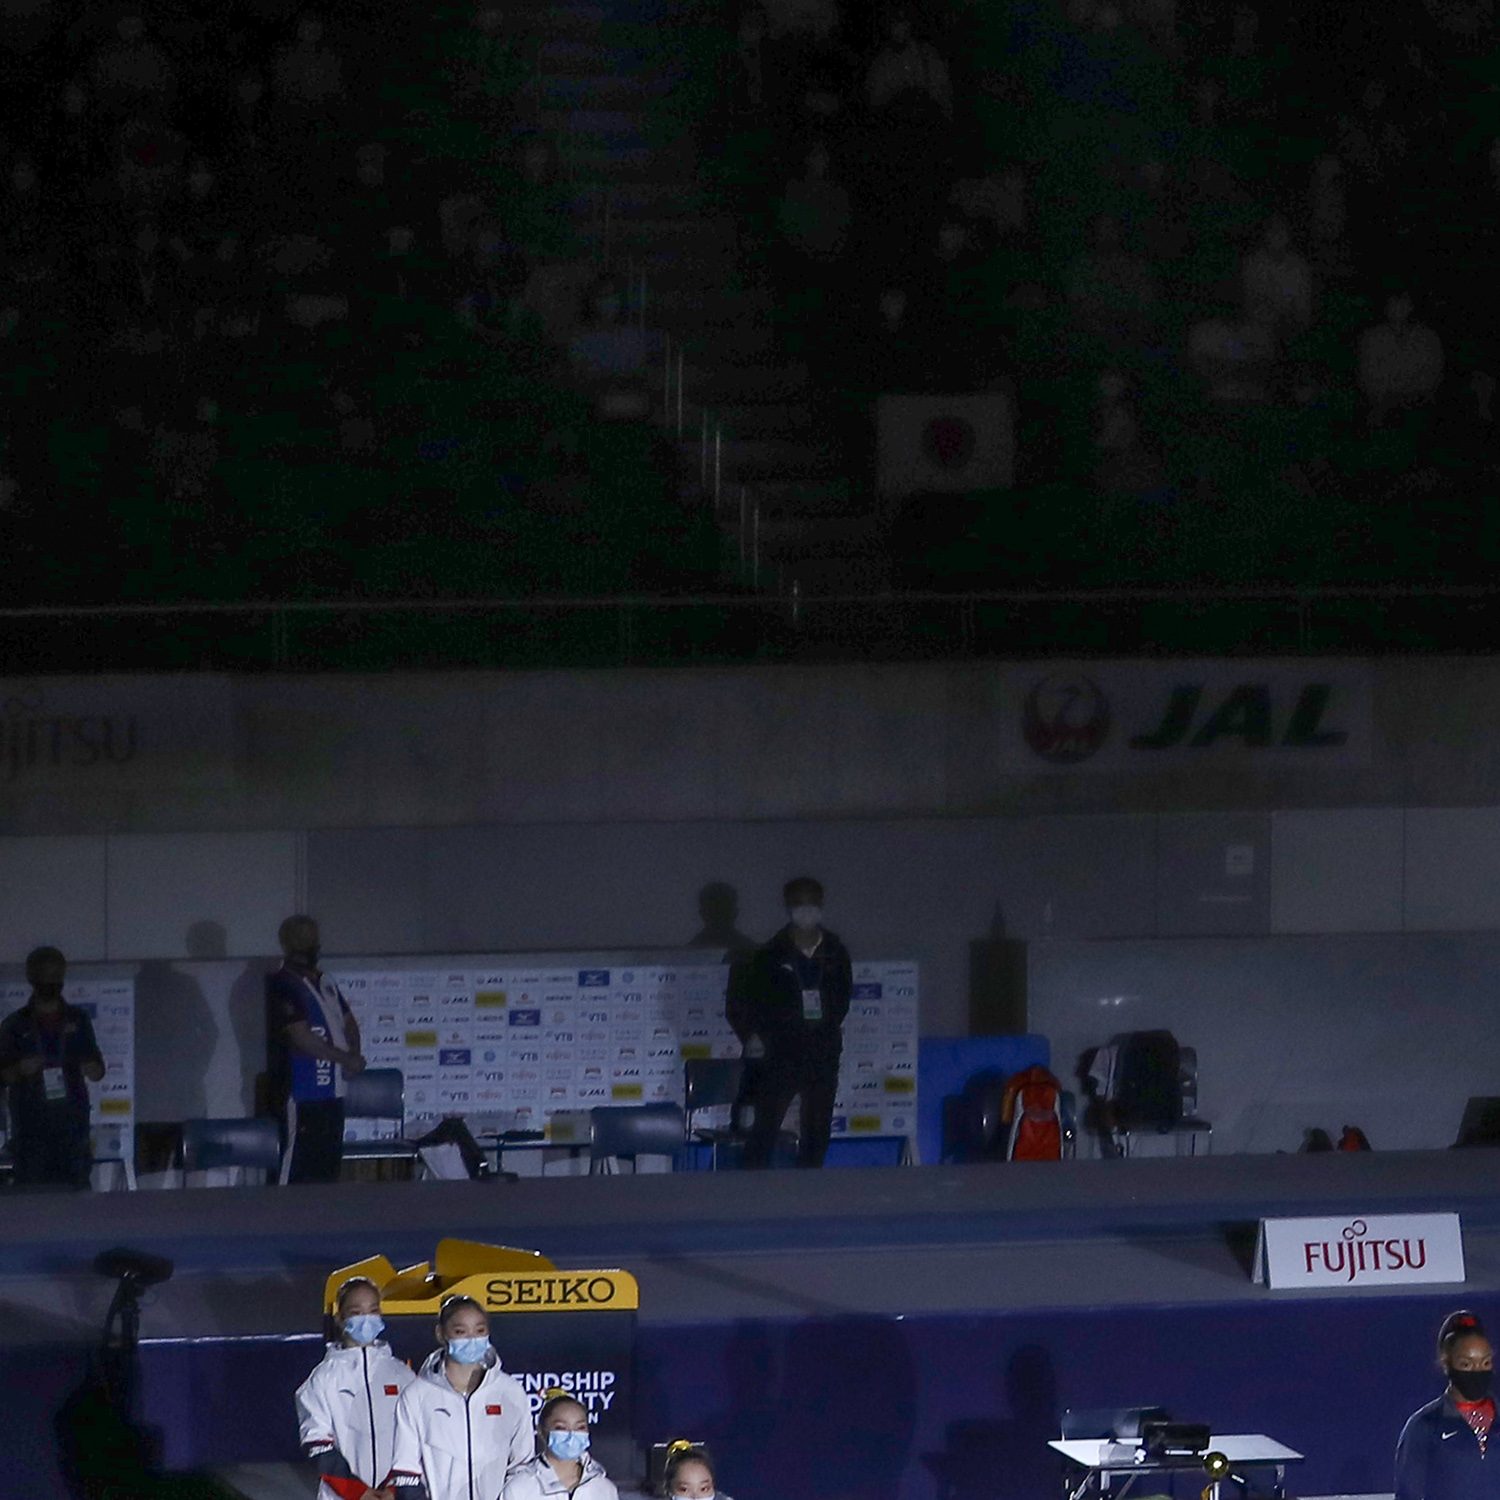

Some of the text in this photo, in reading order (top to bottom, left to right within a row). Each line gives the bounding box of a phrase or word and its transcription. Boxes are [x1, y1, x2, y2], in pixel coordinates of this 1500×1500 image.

[1128, 684, 1348, 748] JAL
[0, 714, 137, 783] JITSU
[1305, 1239, 1426, 1282] FUJITSU
[486, 1277, 615, 1305] SEIKO
